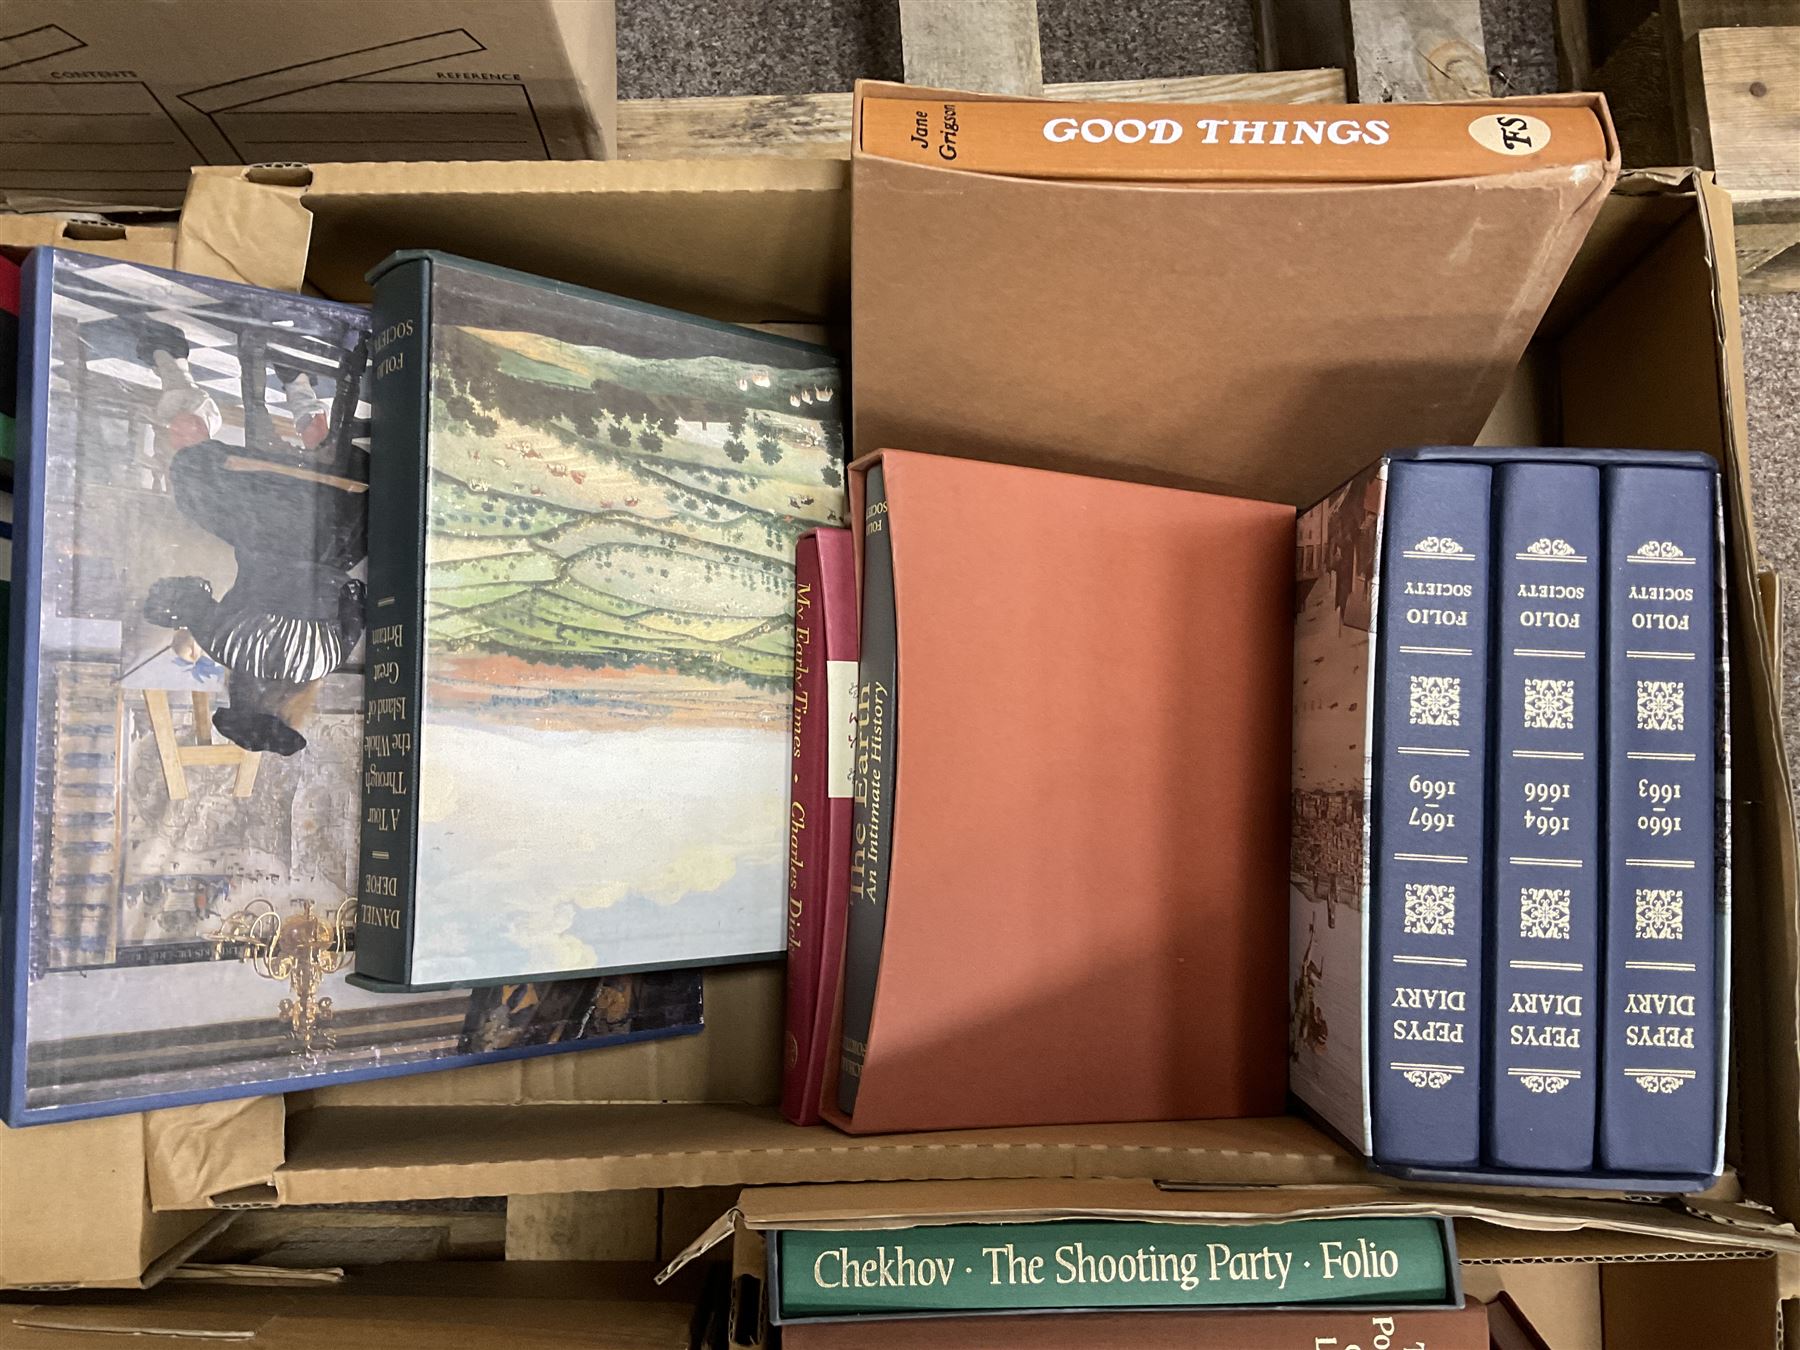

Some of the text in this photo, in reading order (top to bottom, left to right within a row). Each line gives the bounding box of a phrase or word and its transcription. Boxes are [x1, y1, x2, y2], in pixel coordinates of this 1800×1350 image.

[50, 70, 138, 79] CONTENTS
[436, 72, 521, 80] REFERENCE
[911, 111, 928, 149] Jane
[939, 104, 959, 160] Grigson
[1043, 118, 1389, 145] GOOD THINGS
[1404, 582, 1472, 598] SOCIETY
[1517, 584, 1584, 599] SOCIETY
[1628, 586, 1693, 601] SOCIETY
[1406, 608, 1467, 626] FOLIO
[1520, 611, 1580, 629] FOLIO
[1632, 613, 1690, 631] FOLIO
[372, 624, 403, 650] Britain
[374, 661, 399, 684] Great
[366, 696, 406, 724] Island of
[793, 691, 808, 758] Times
[364, 732, 411, 758] the Whole
[854, 682, 871, 808] Earth
[365, 764, 406, 794] Through
[1409, 775, 1456, 800] 1669
[866, 681, 888, 904] An Intimate History
[1524, 783, 1570, 804] 1666
[1639, 779, 1681, 804] 1663
[368, 808, 400, 831] A Tour
[1408, 807, 1455, 832] 1667
[1524, 810, 1570, 836] 1664
[1638, 815, 1682, 836] 1660
[790, 801, 805, 889] Charles
[365, 873, 397, 897] DEFOE
[361, 904, 400, 929] DANIEL
[1392, 987, 1466, 1011] DIARY
[1508, 993, 1582, 1016] DIARY
[1624, 993, 1695, 1016] DIARY
[1393, 1020, 1464, 1043] PEPYS
[1511, 1025, 1580, 1048] PEPYS
[1626, 1025, 1694, 1049] PEPYS
[814, 1238, 1398, 1291] Chekhov The Shooting Party Folio
